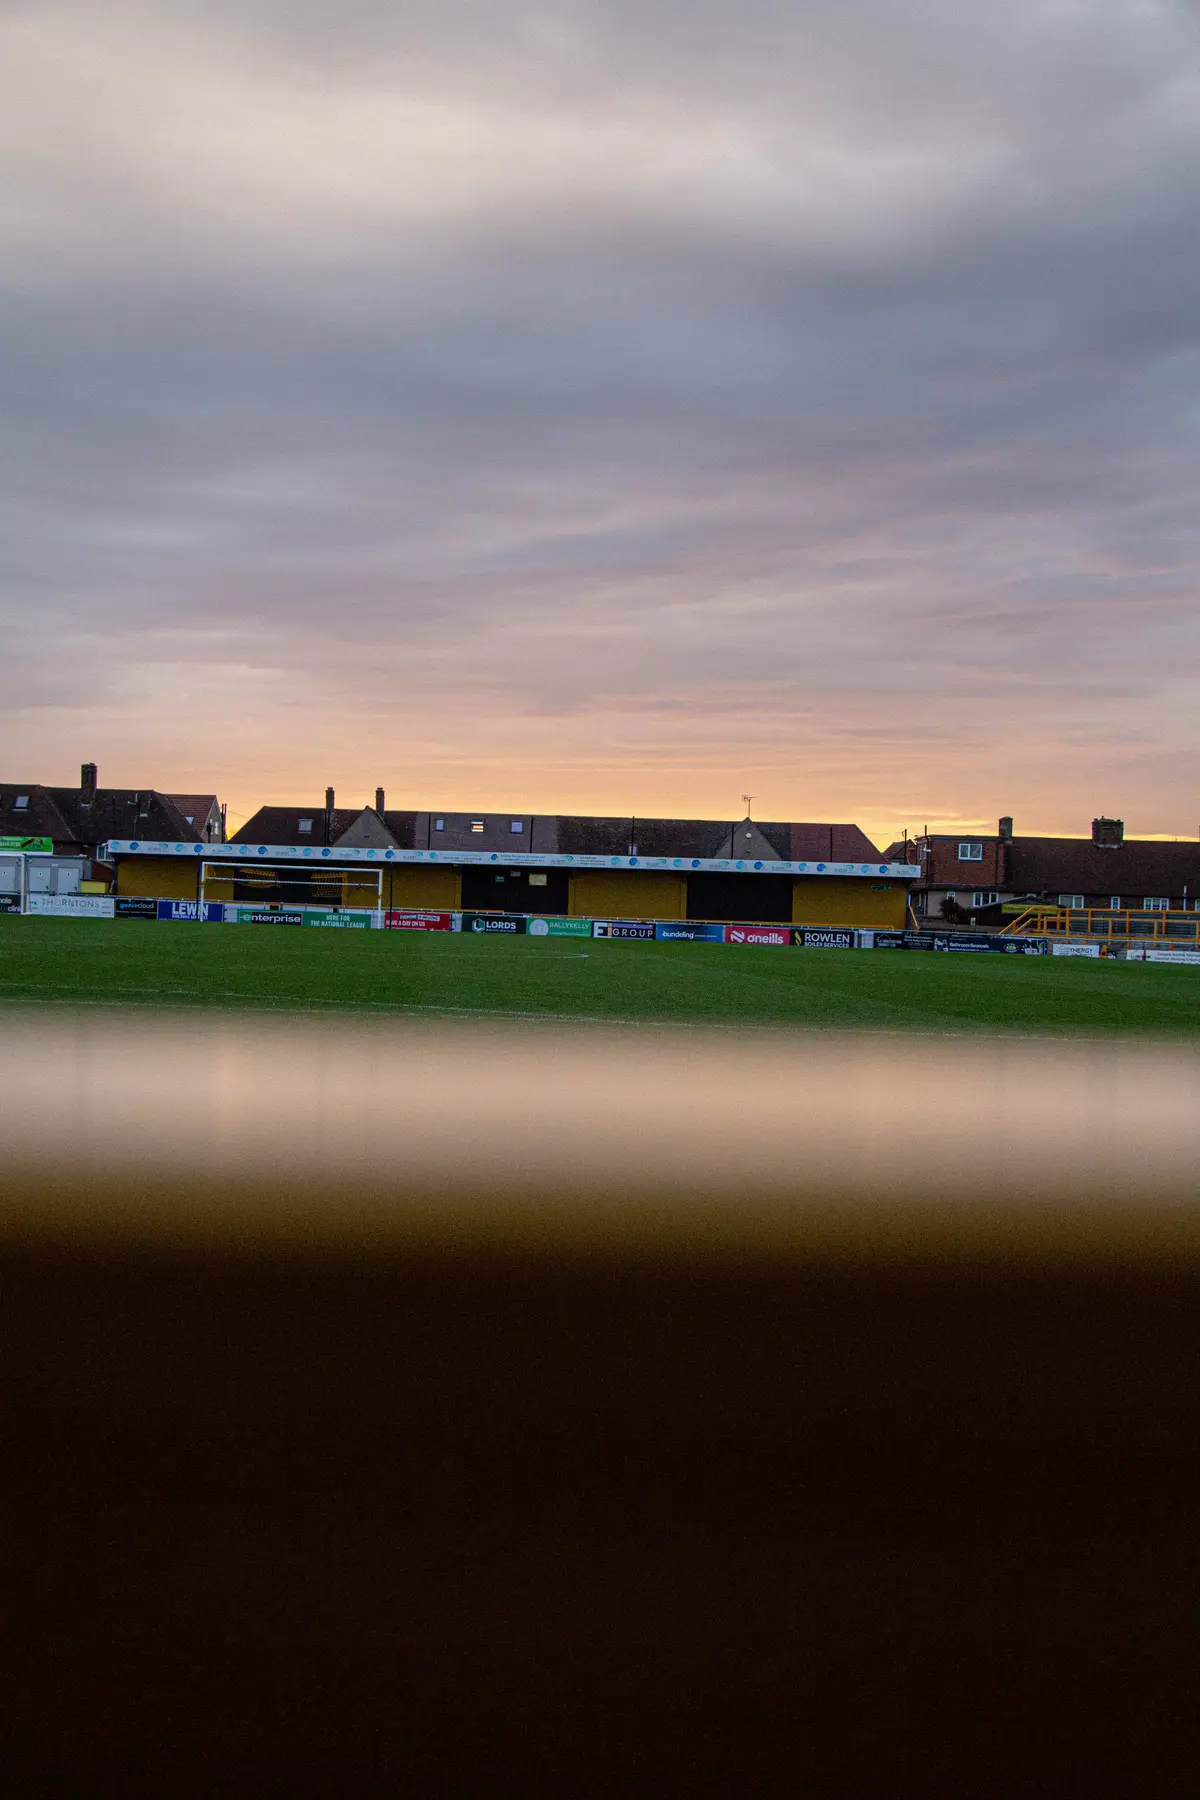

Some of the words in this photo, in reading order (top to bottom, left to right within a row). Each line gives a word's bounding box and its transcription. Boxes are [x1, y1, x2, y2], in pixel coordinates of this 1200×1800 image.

[42, 898, 99, 908] THORNTONS
[241, 913, 301, 923] enterprise
[321, 920, 345, 928] NATIONAL
[486, 921, 516, 930] LORDS
[612, 928, 653, 937] GROUP
[804, 932, 850, 943] ROWLEN
